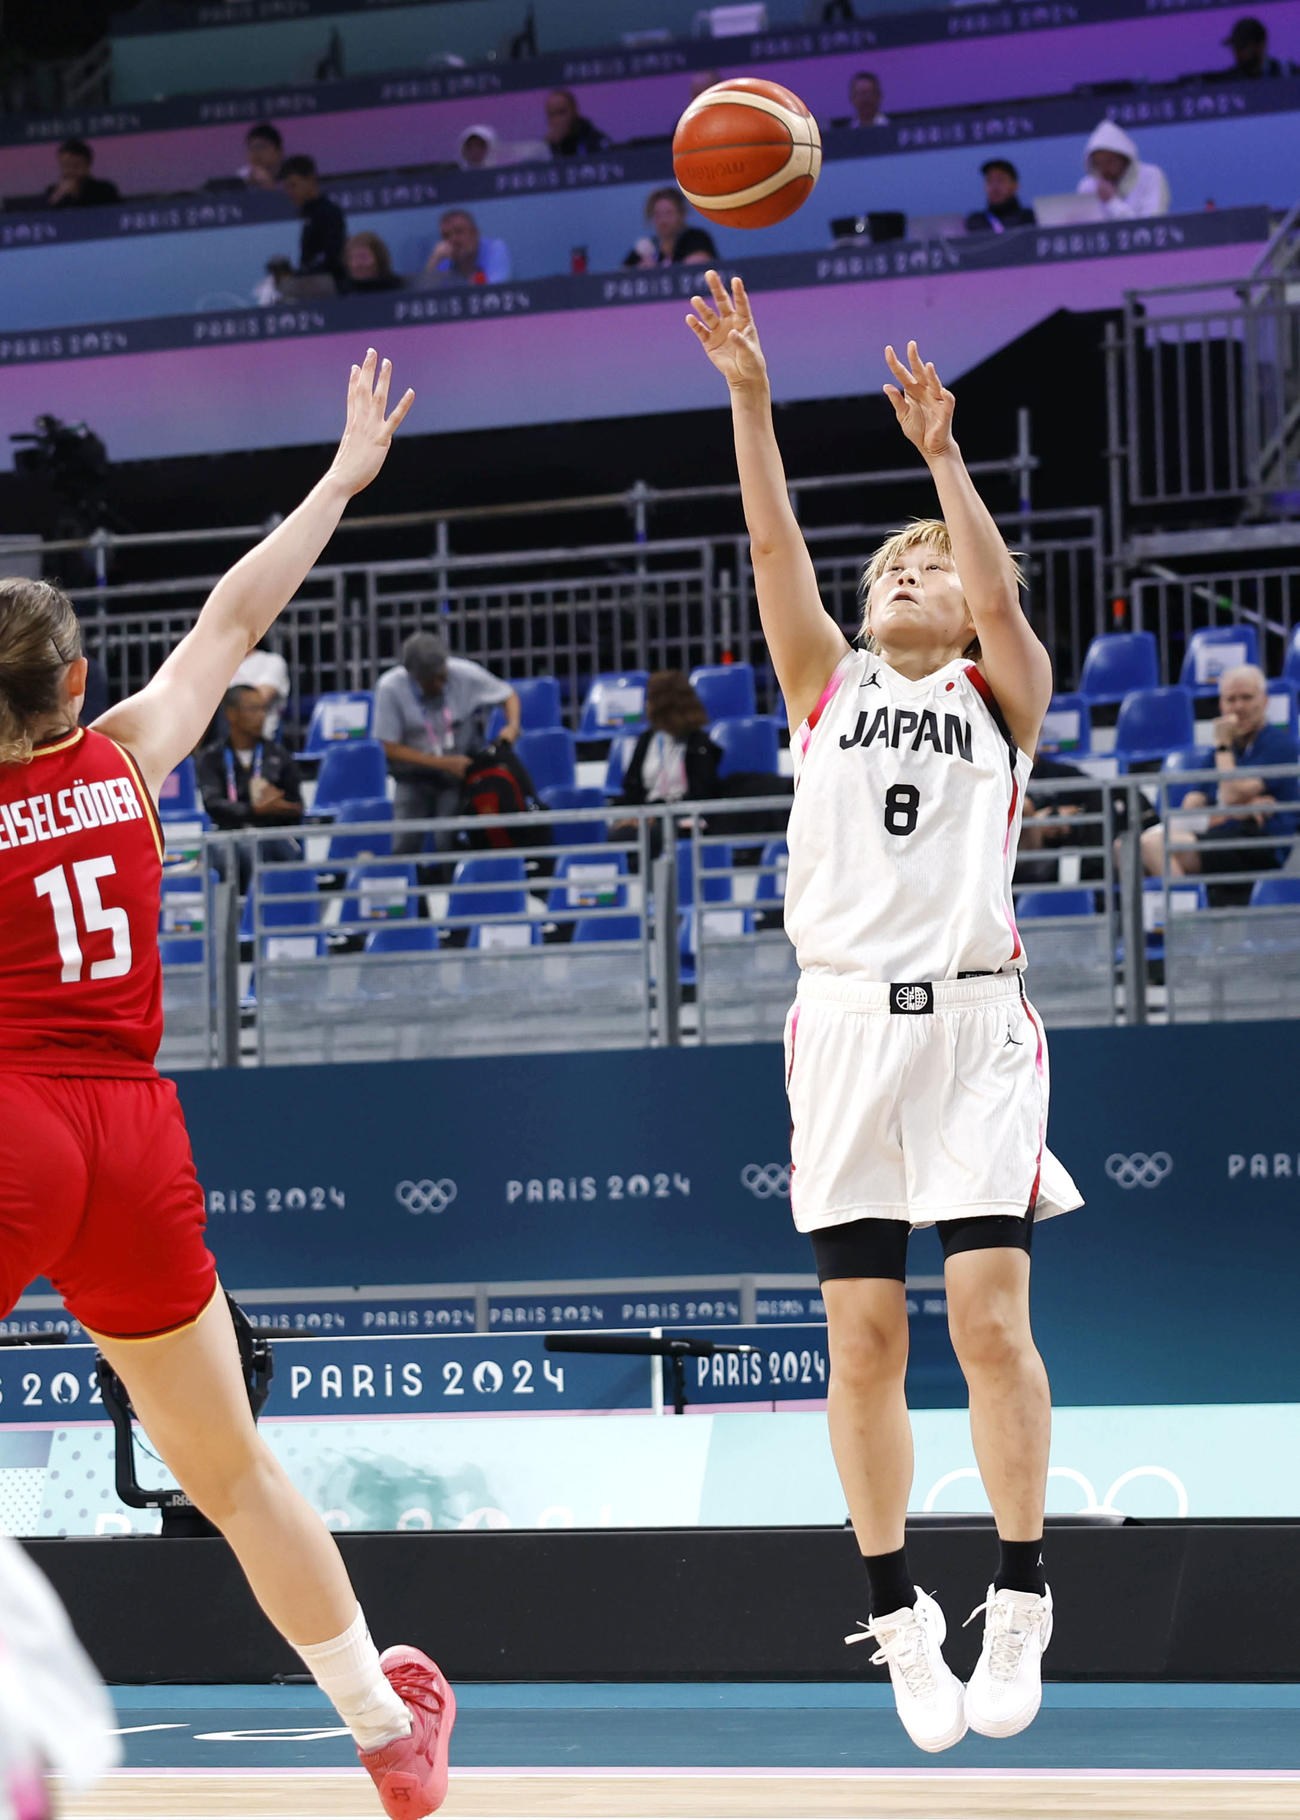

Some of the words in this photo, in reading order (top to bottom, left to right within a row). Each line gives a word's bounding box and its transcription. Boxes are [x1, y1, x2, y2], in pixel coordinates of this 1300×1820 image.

[687, 161, 745, 182] molten
[839, 706, 973, 764] JAPAN
[884, 783, 920, 836] 8
[34, 855, 133, 983] 15
[265, 1185, 346, 1213] 2024
[607, 1171, 690, 1200] 2024
[295, 1313, 345, 1331] 2024
[424, 1309, 475, 1328] 2024
[552, 1304, 603, 1322] 2024
[685, 1301, 739, 1319] 2024
[44, 1320, 82, 1336] 202
[443, 1359, 564, 1396] 2024
[769, 1350, 825, 1384] 2024
[22, 1371, 104, 1406] 202
